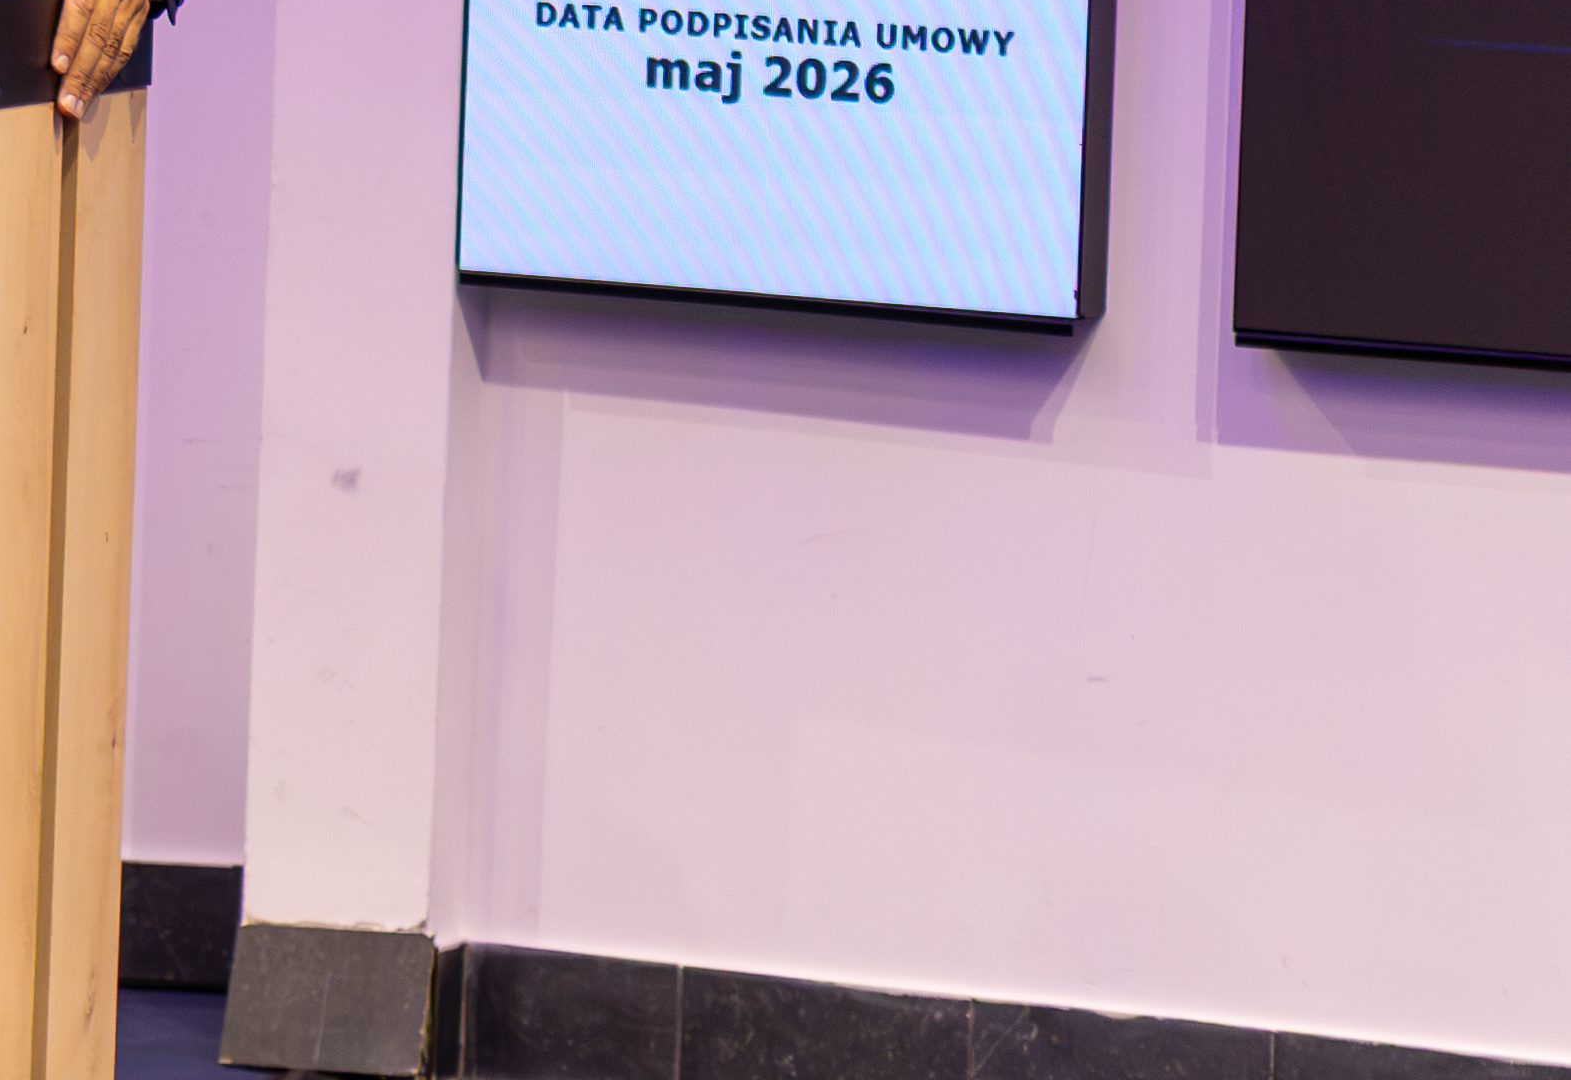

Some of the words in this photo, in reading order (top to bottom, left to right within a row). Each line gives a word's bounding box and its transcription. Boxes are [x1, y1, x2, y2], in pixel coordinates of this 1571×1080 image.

[536, 1, 624, 32] DATA
[639, 7, 861, 48] PODPISANIA
[875, 23, 1015, 56] UMOWY
[646, 51, 742, 104] maj
[763, 55, 896, 103] 2026
